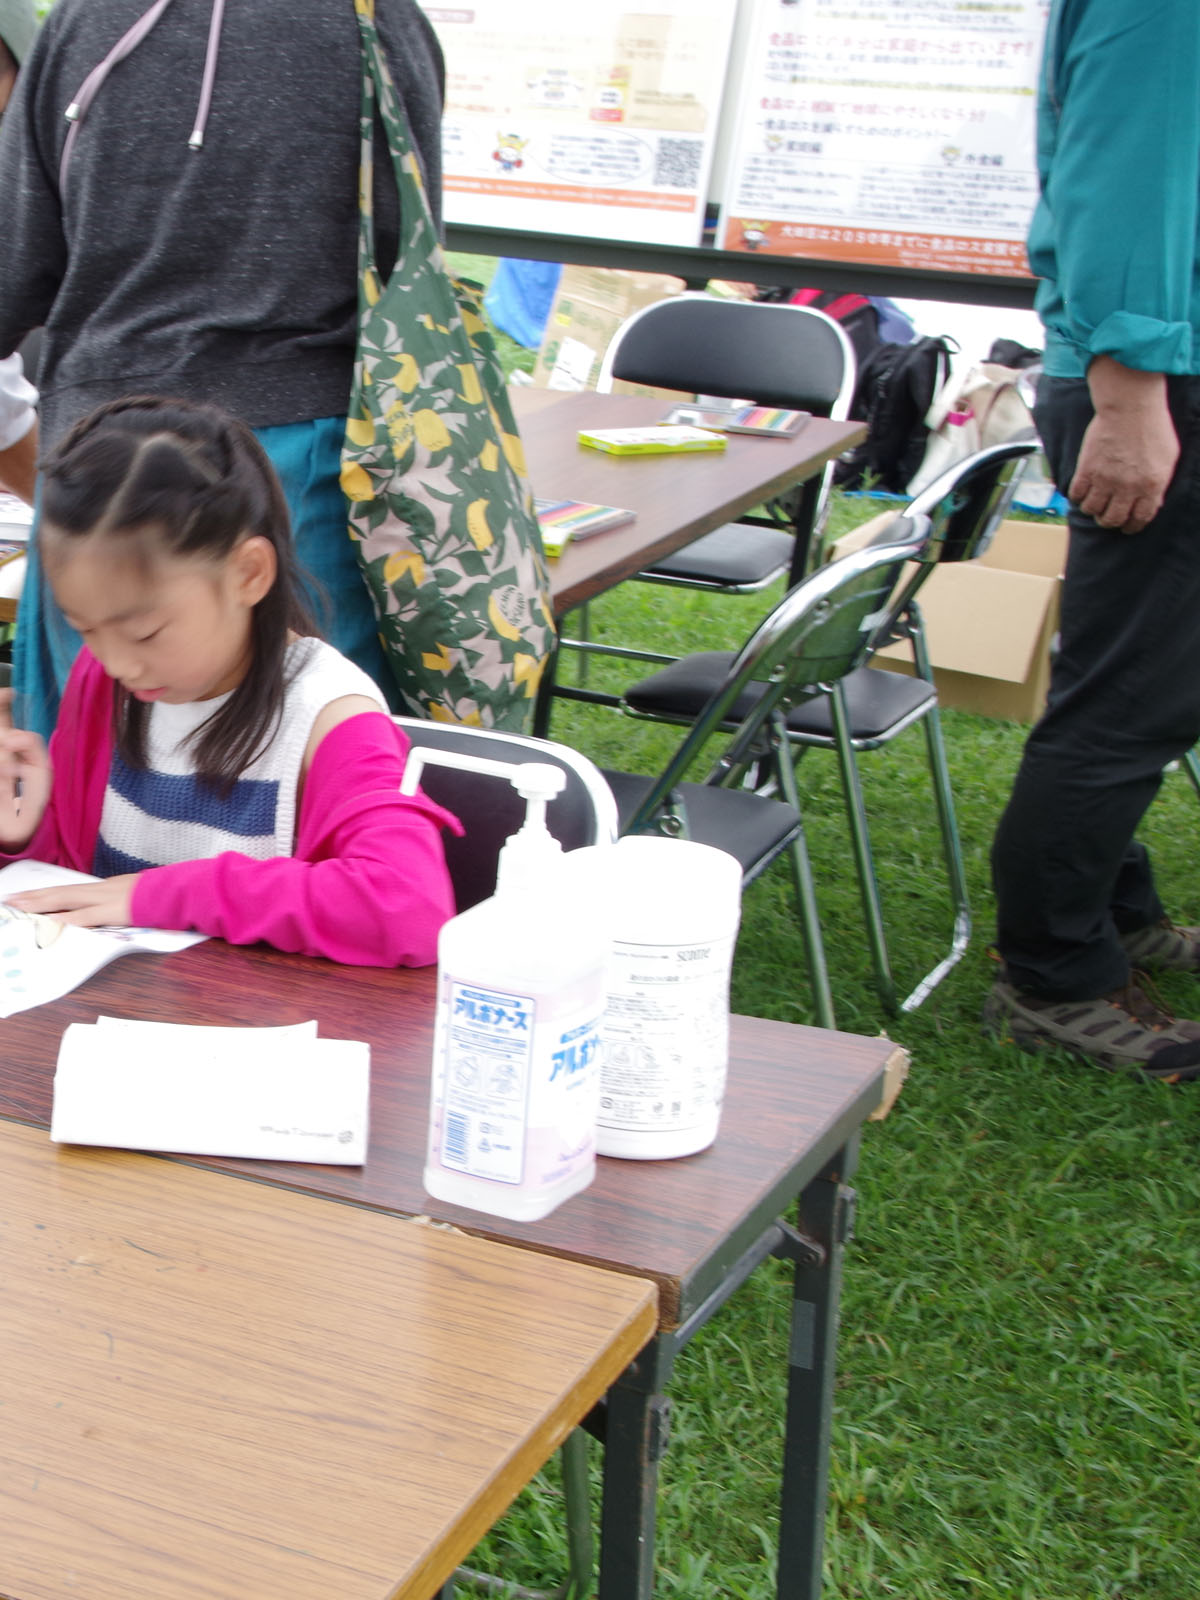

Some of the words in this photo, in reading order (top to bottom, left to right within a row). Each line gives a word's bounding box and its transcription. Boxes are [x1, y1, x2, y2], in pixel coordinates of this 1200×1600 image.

[453, 997, 528, 1031] アルボナース
